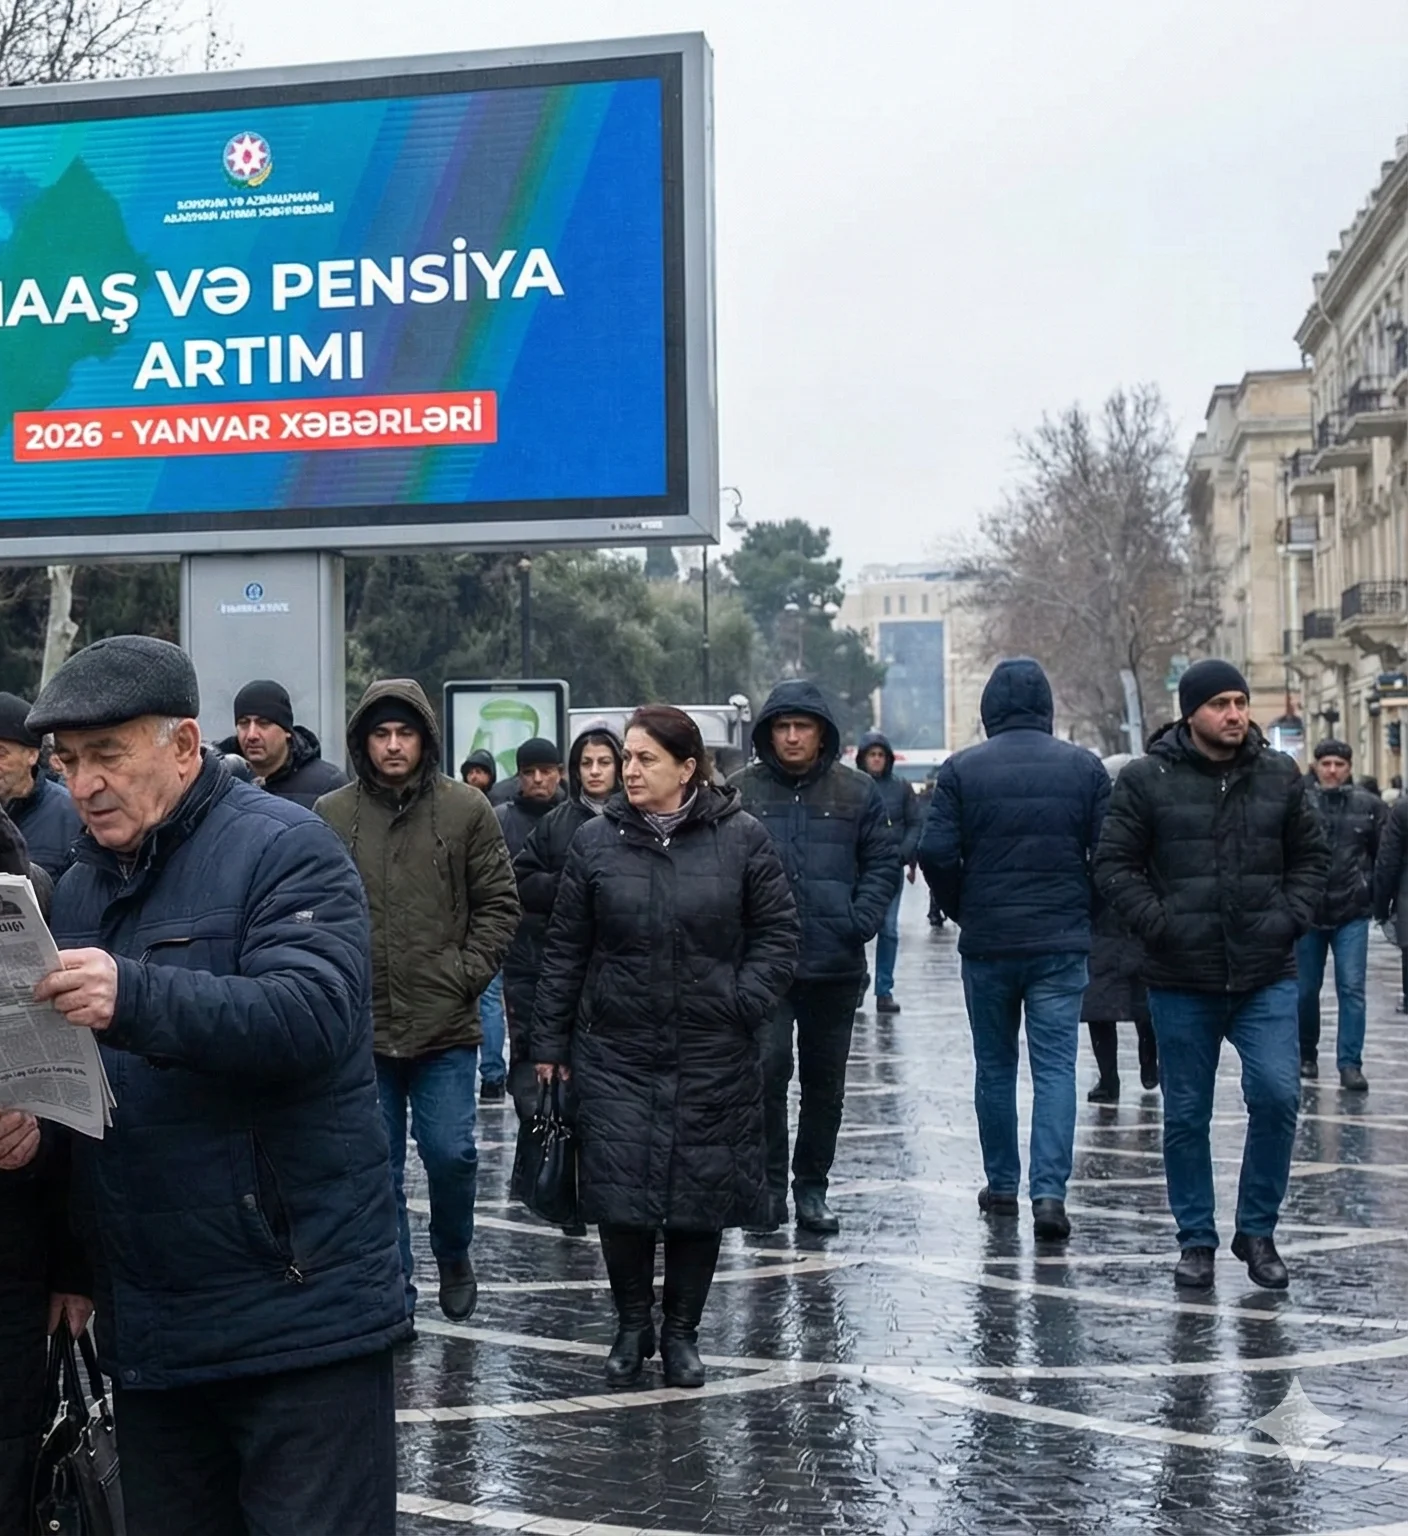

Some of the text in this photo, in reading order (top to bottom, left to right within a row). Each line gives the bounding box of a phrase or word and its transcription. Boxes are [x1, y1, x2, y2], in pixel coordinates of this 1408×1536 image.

[156, 267, 250, 316] VƏ
[272, 237, 565, 312] PENSİYA
[133, 331, 364, 389] ARTIMI
[24, 421, 103, 450] 2026
[131, 411, 270, 446] YANVAR
[279, 397, 483, 440] XƏBƏRLƏRİ
